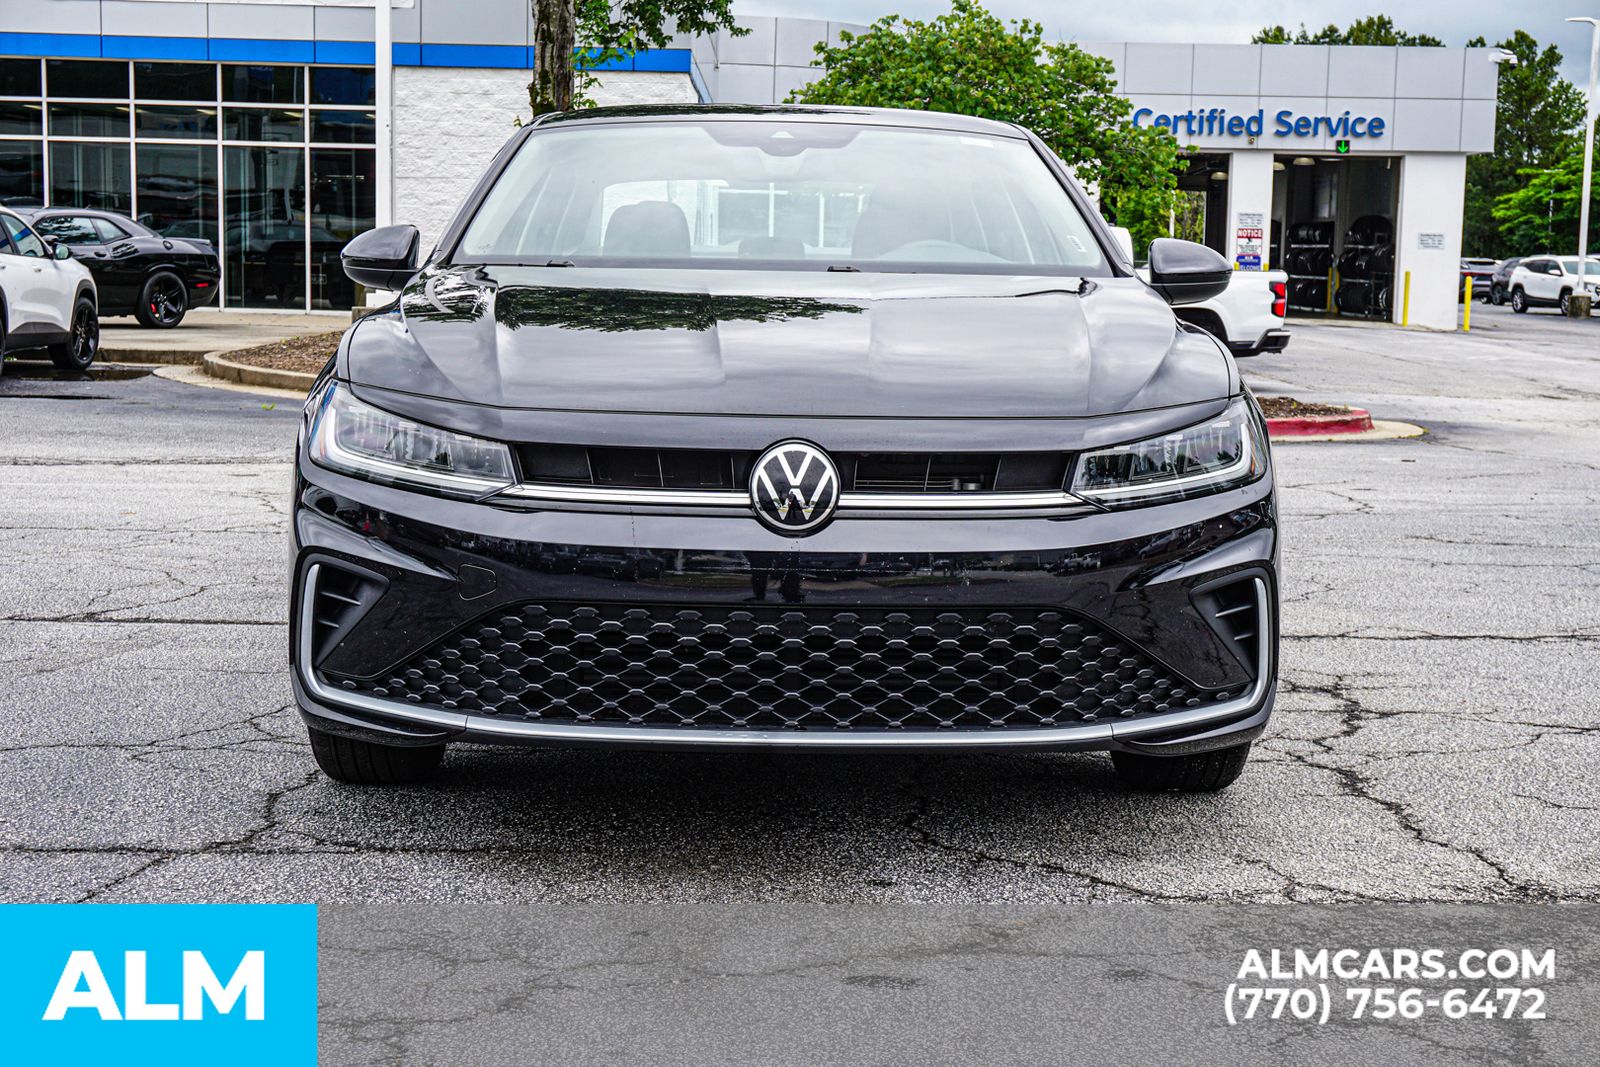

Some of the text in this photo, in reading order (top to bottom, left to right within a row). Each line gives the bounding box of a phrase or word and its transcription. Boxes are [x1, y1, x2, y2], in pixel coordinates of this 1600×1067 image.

[1132, 107, 1386, 137] Certified Service
[1237, 229, 1262, 238] NOTICE
